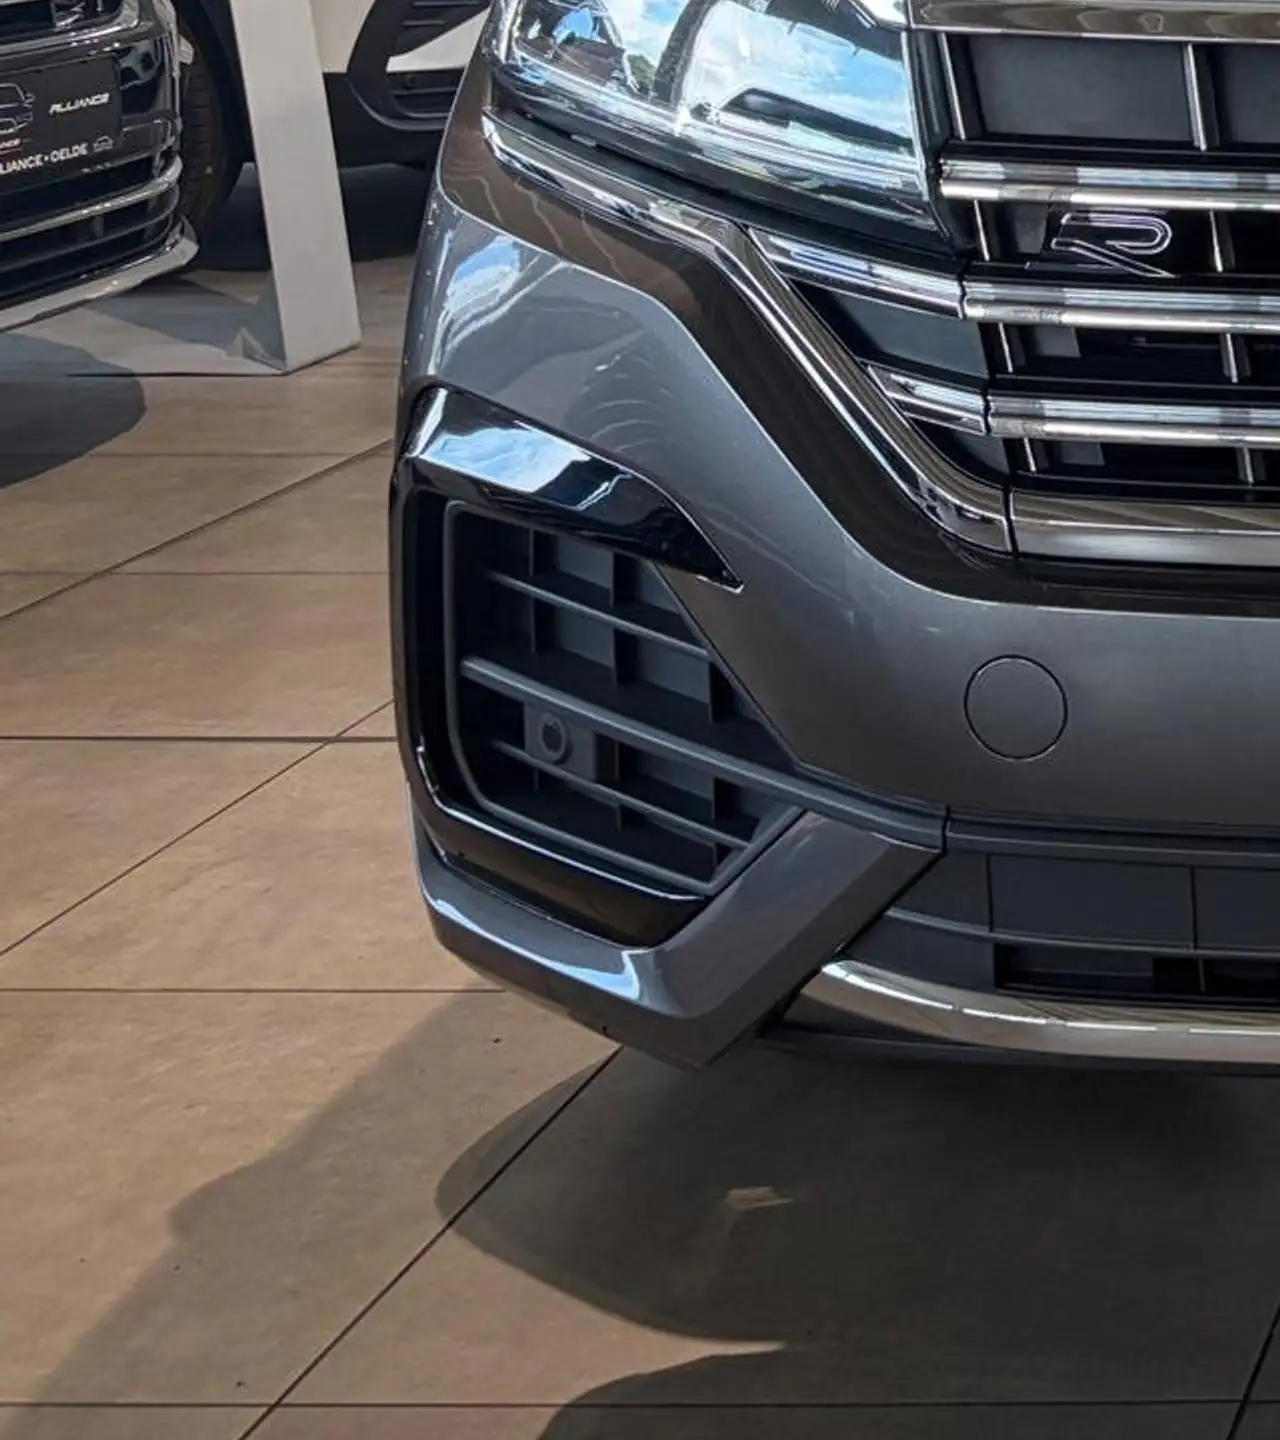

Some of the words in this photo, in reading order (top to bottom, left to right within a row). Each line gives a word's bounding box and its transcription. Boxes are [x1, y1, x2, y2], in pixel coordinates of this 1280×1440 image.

[48, 92, 110, 115] ALLIANCE
[50, 142, 89, 163] OELDE
[1050, 212, 1177, 279] R
